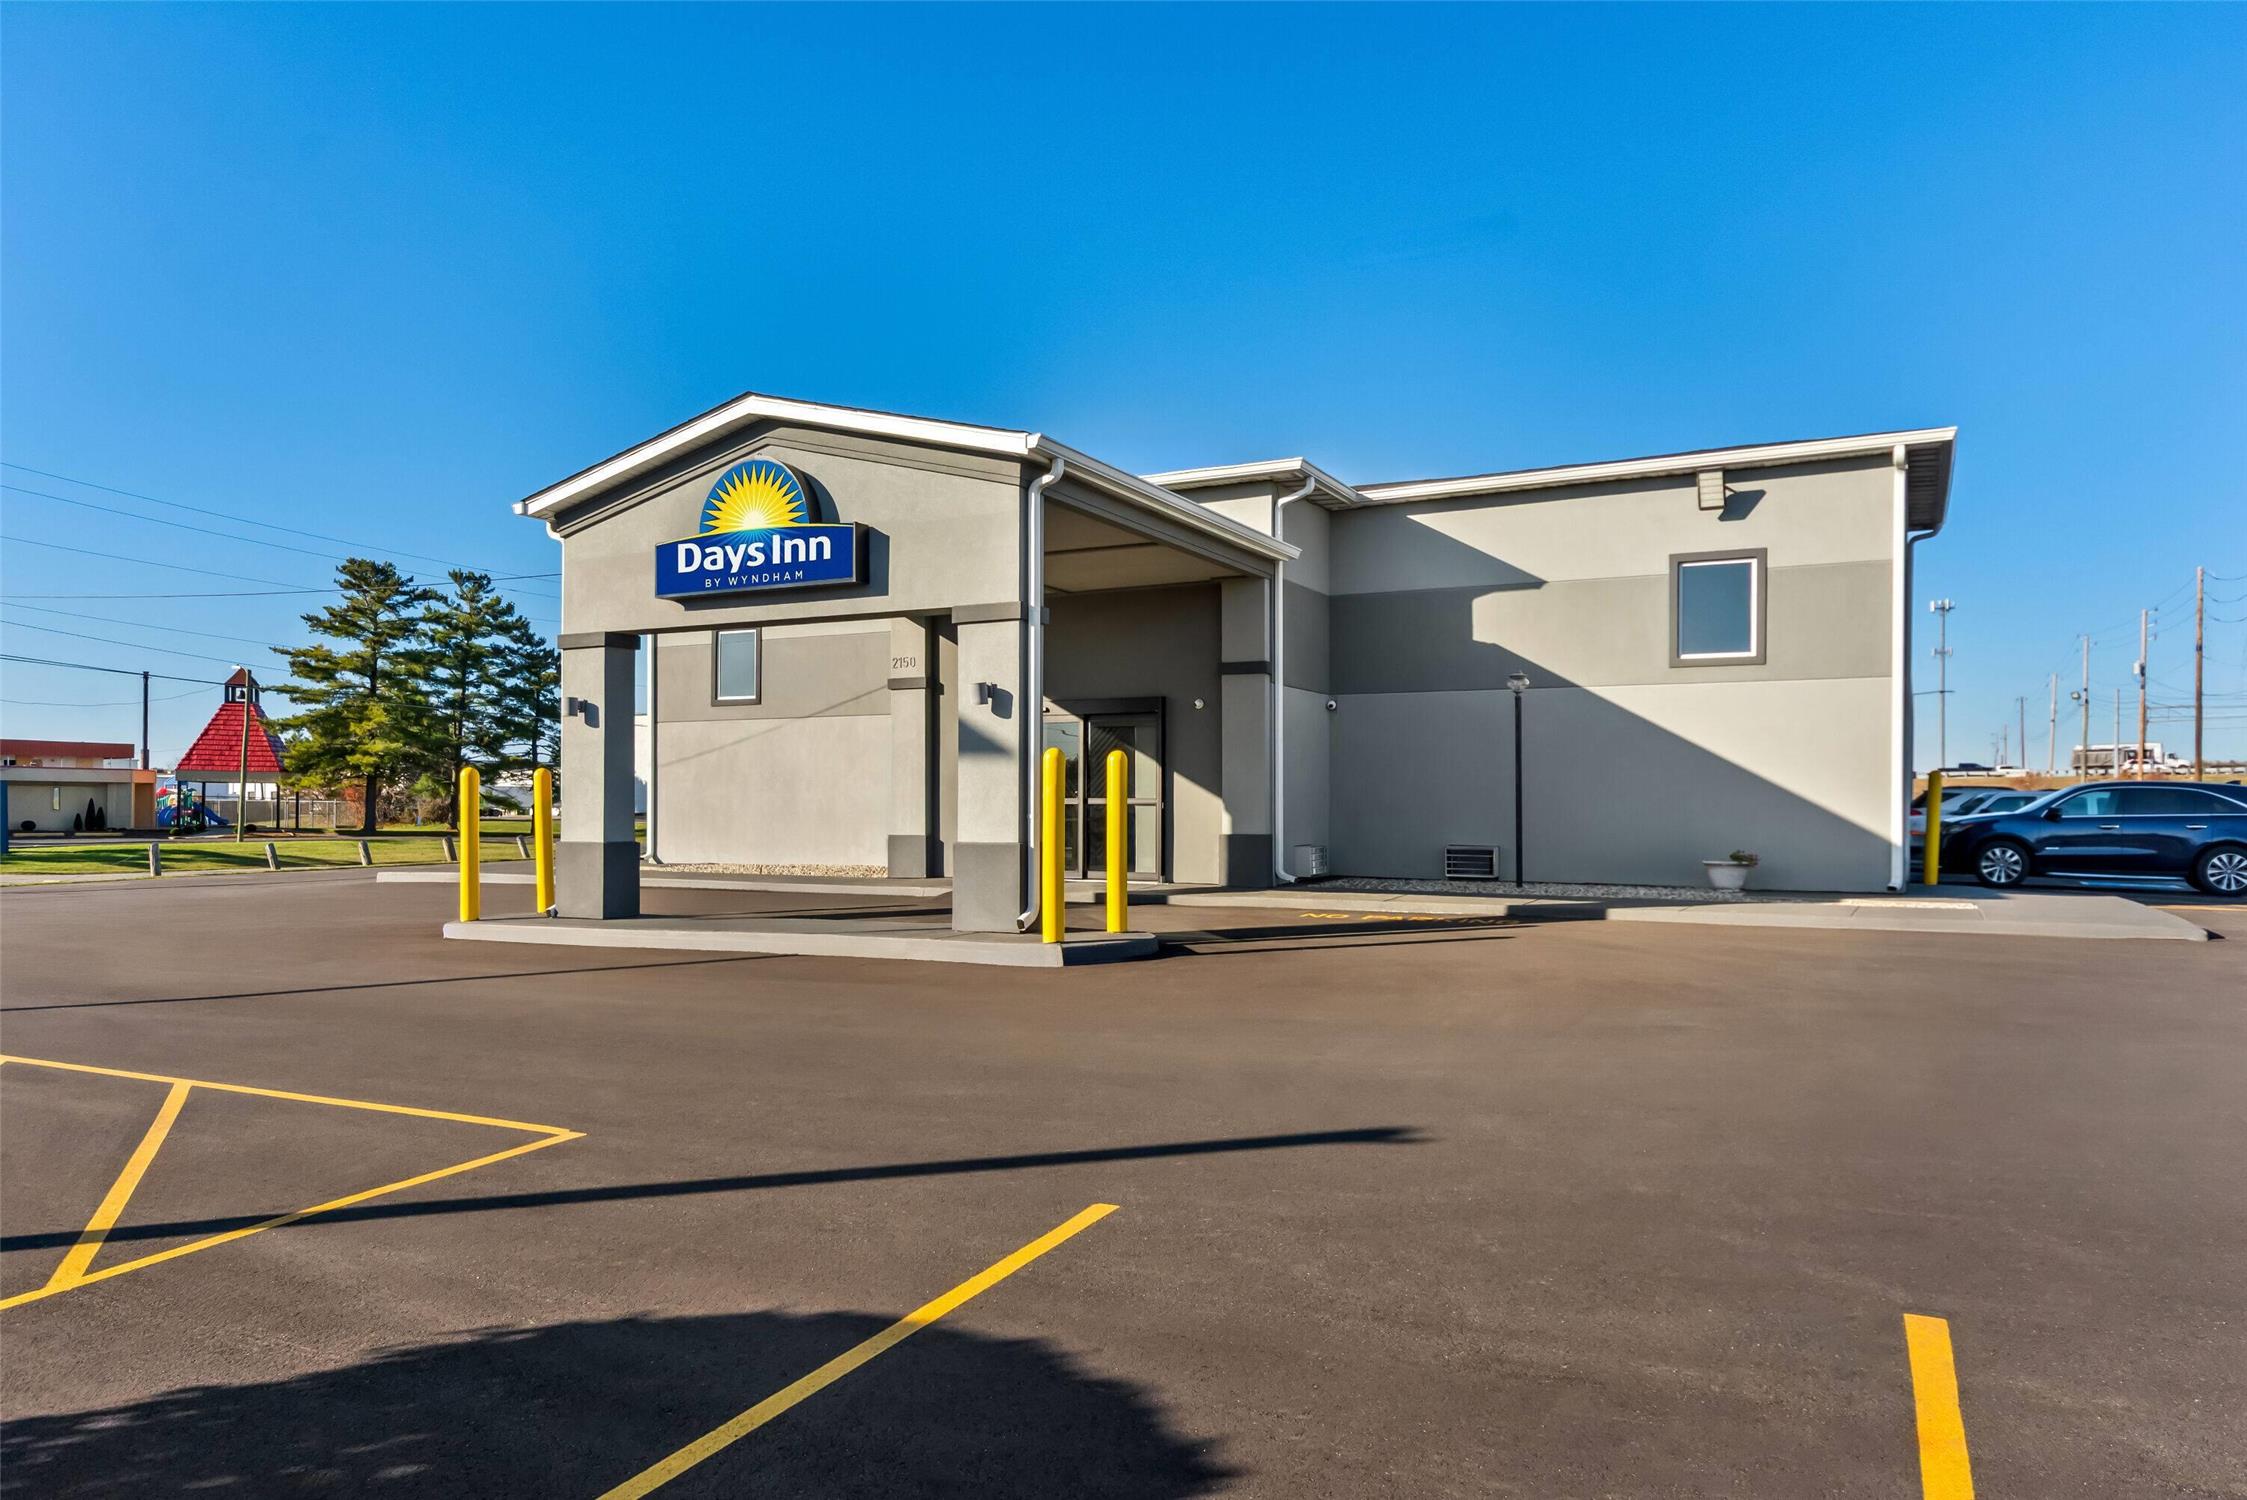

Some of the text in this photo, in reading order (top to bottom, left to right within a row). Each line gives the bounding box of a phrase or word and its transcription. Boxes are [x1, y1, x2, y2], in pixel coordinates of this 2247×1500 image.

[677, 534, 831, 573] Days Inn
[705, 570, 803, 588] BY WYNDHAM
[892, 656, 916, 669] 2150
